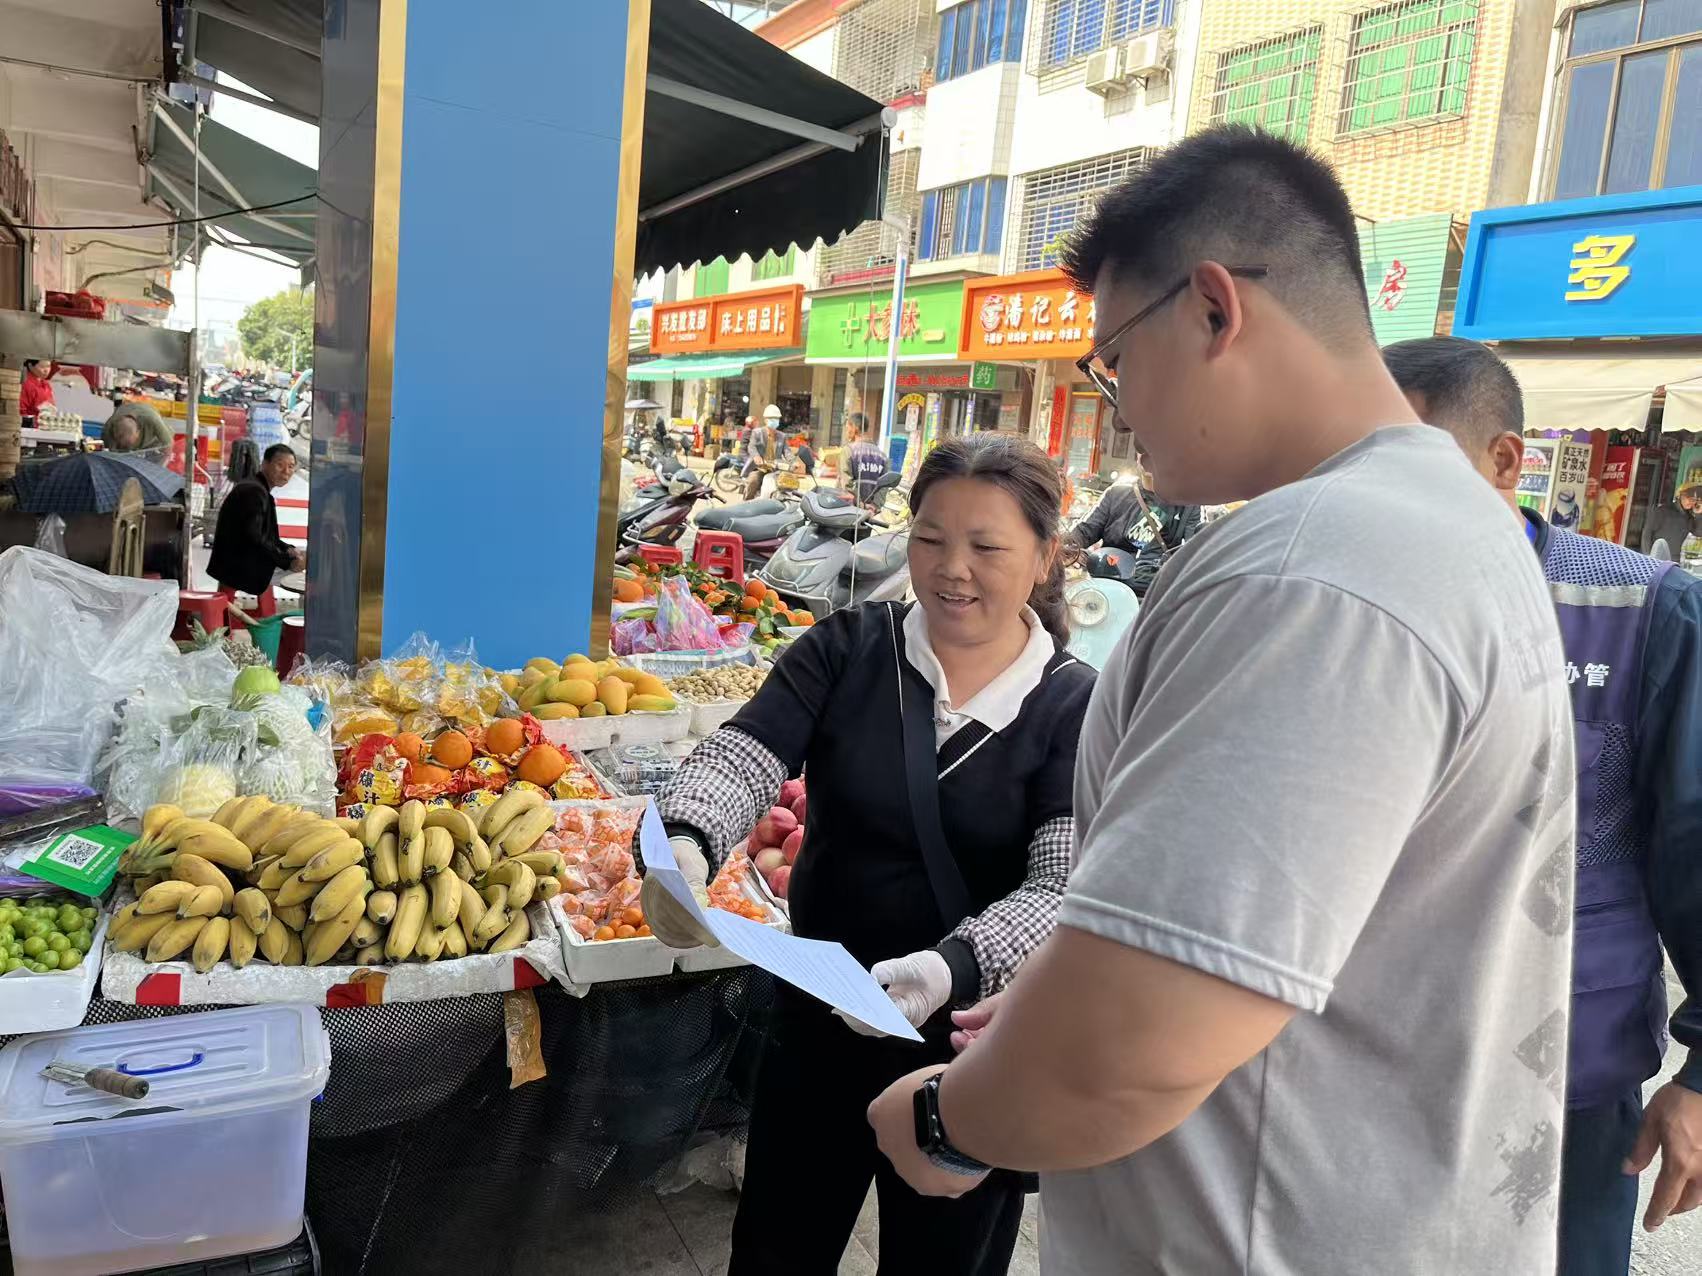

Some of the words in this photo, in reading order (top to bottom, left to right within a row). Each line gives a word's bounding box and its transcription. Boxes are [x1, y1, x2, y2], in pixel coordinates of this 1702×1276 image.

[1565, 234, 1637, 303] 多
[976, 365, 992, 385] 药
[1559, 471, 1585, 484] 百岁山
